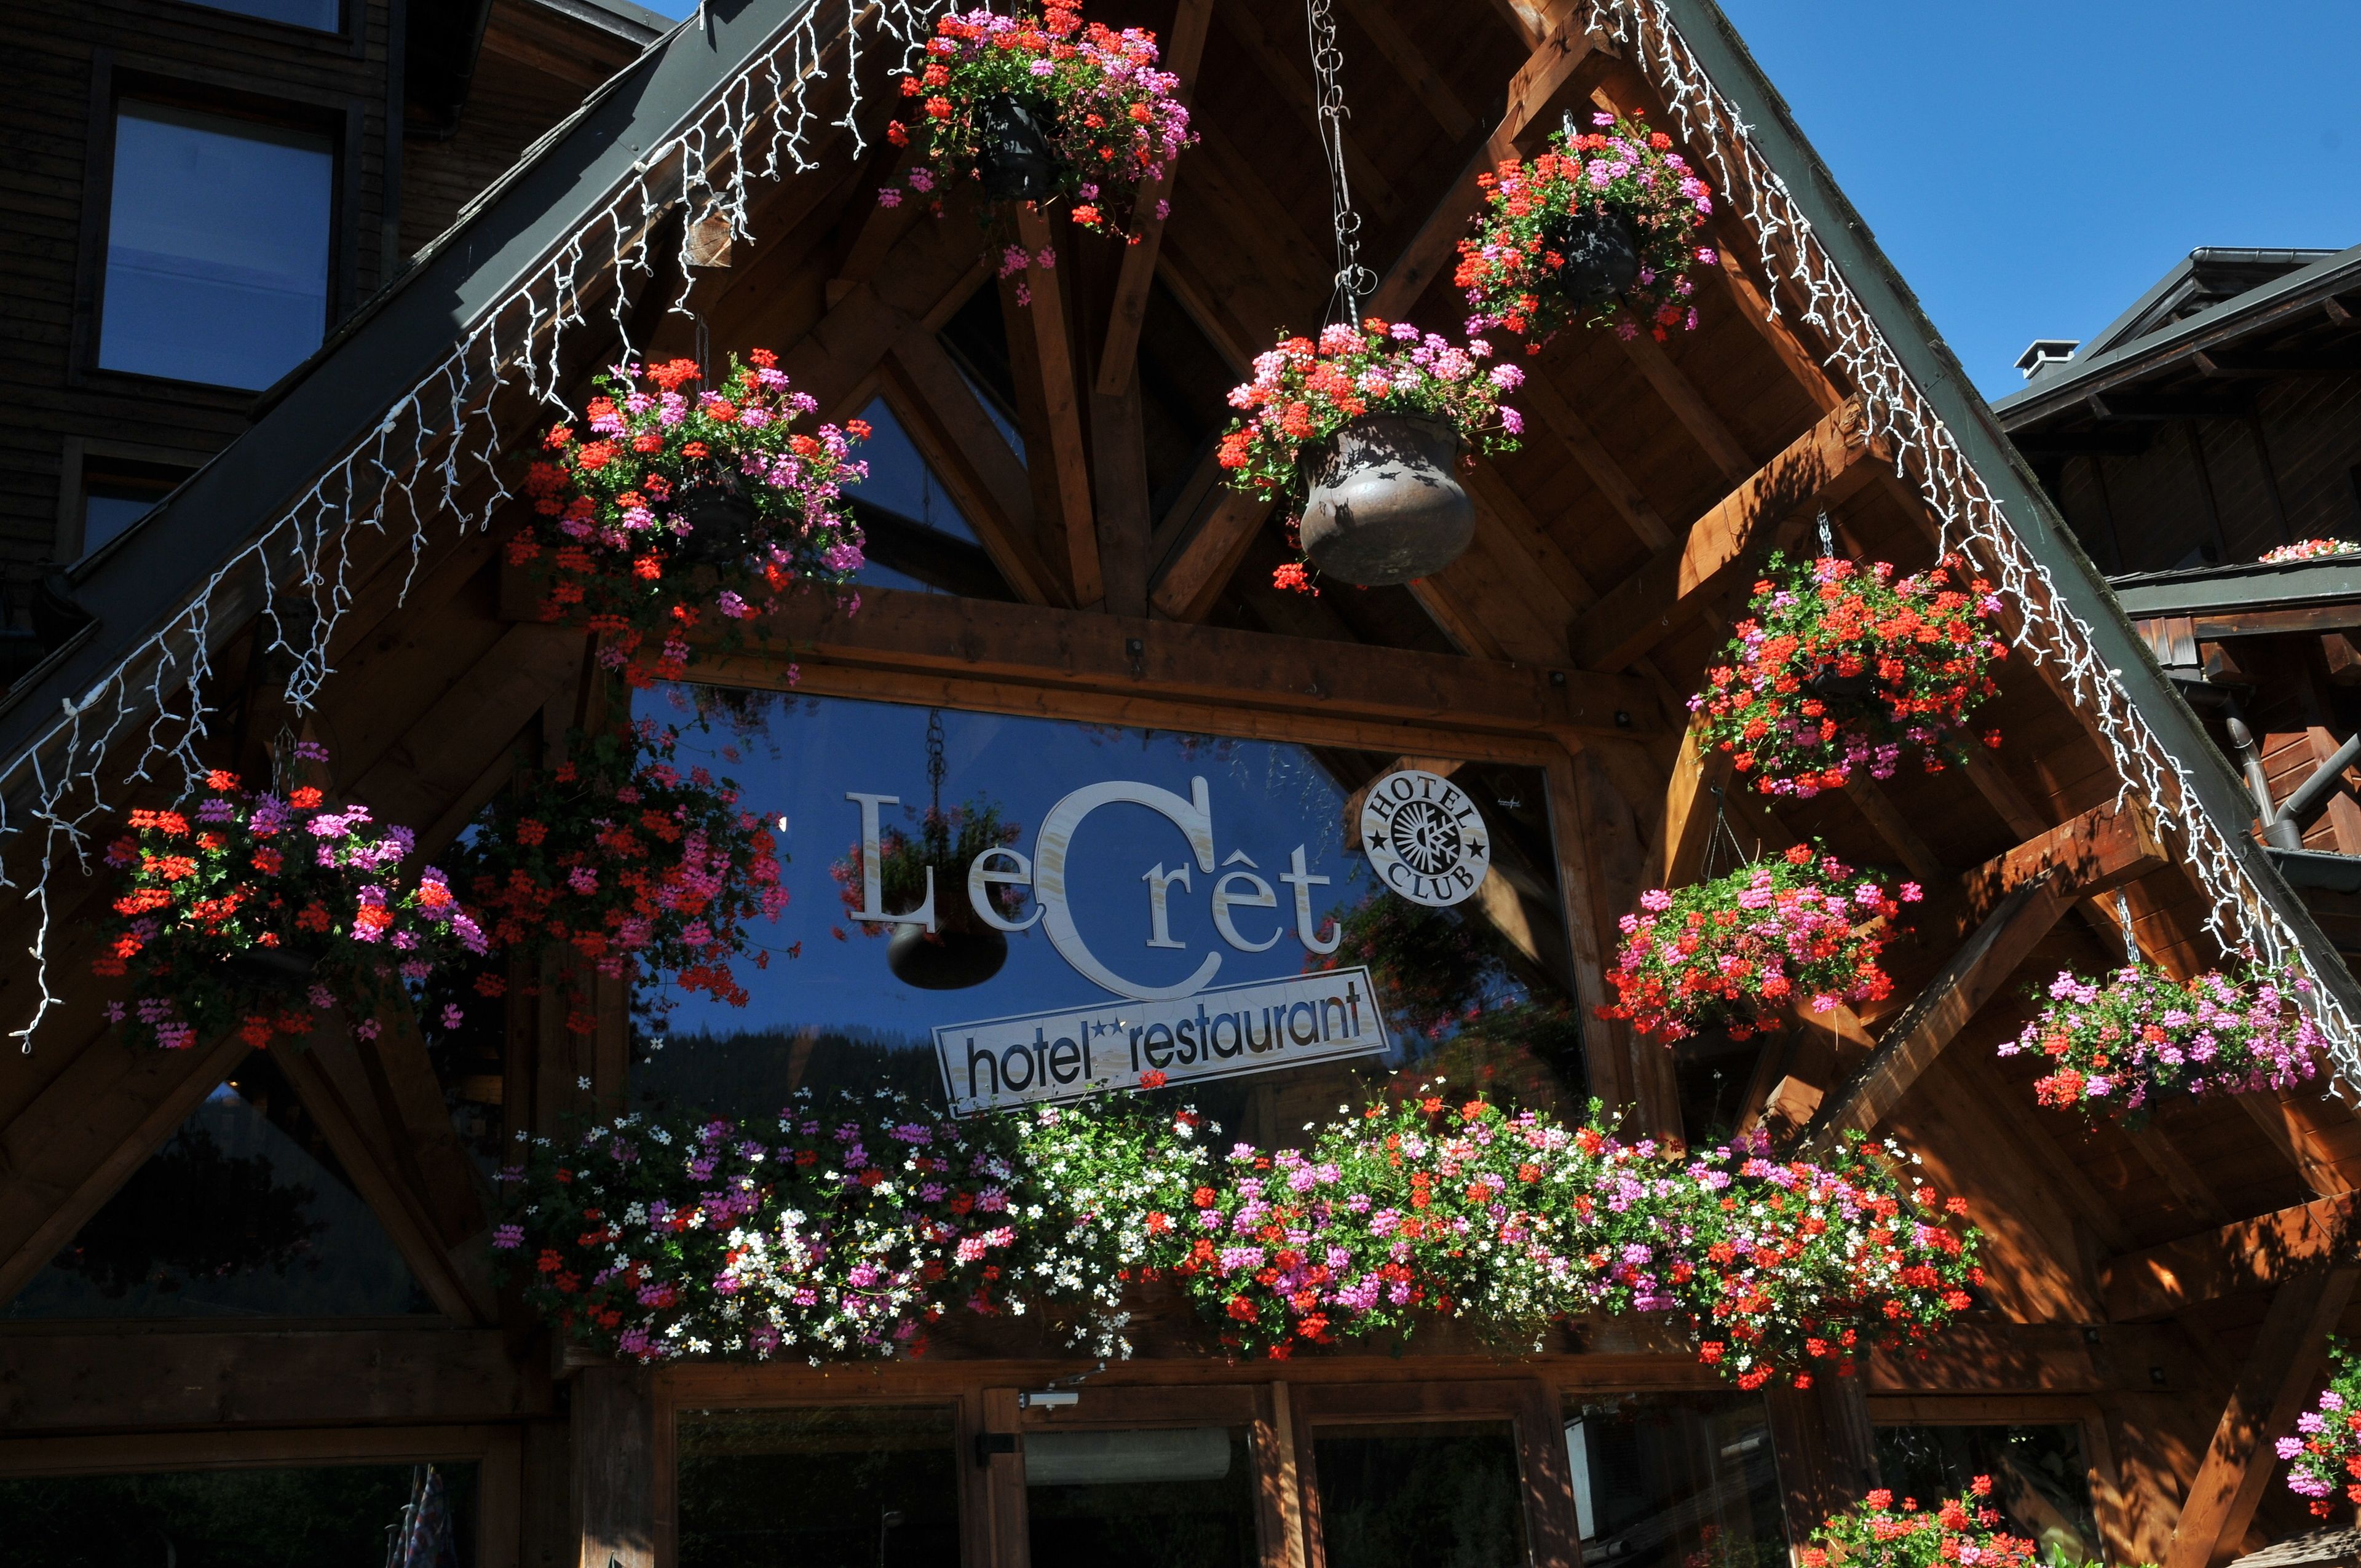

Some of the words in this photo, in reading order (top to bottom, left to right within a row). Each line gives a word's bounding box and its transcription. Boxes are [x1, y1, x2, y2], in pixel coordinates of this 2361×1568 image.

[1368, 775, 1475, 828] HOTEL
[846, 792, 1046, 933] Le
[1034, 775, 1341, 1002] Crêt
[1388, 862, 1474, 900] CLUB
[967, 1021, 1092, 1098] hotel
[1129, 981, 1361, 1072] restaurant
